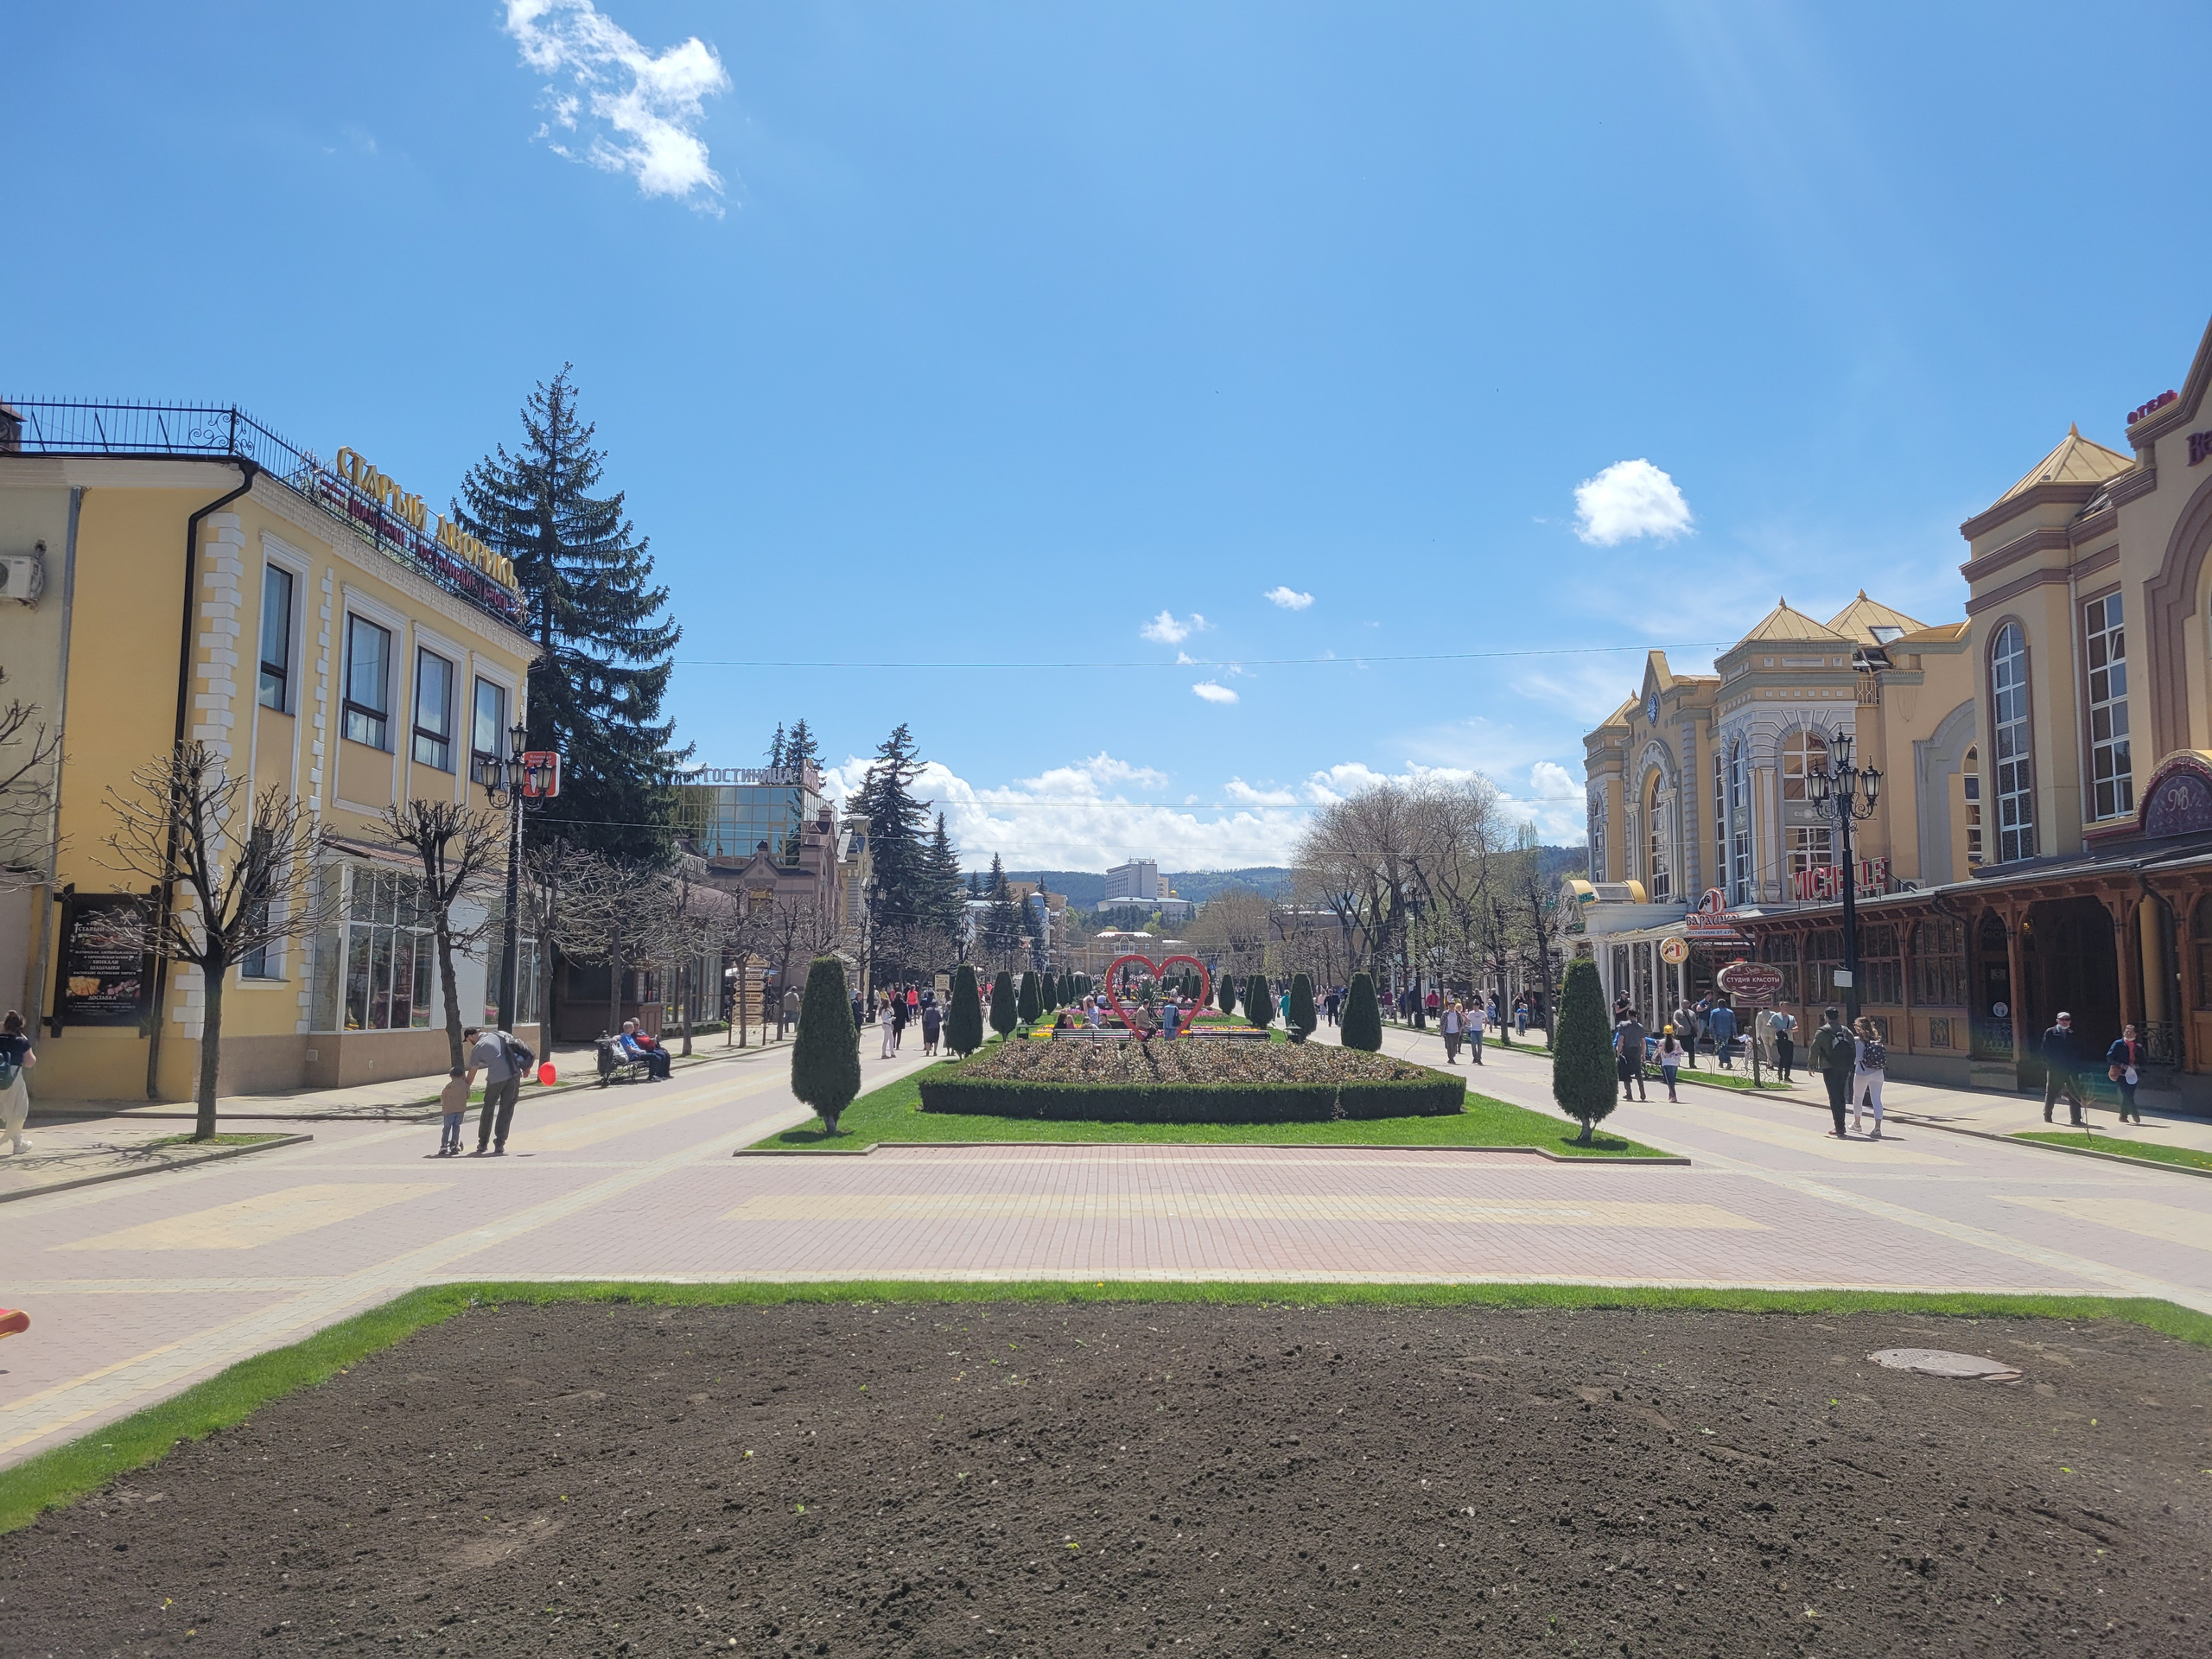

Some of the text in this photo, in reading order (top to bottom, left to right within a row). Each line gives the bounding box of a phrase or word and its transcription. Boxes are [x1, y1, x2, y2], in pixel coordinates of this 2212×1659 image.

[337, 446, 428, 531] СТАРЫЙ
[704, 768, 794, 783] ГОСТИНИЦА
[1792, 856, 1887, 900] MICHELE
